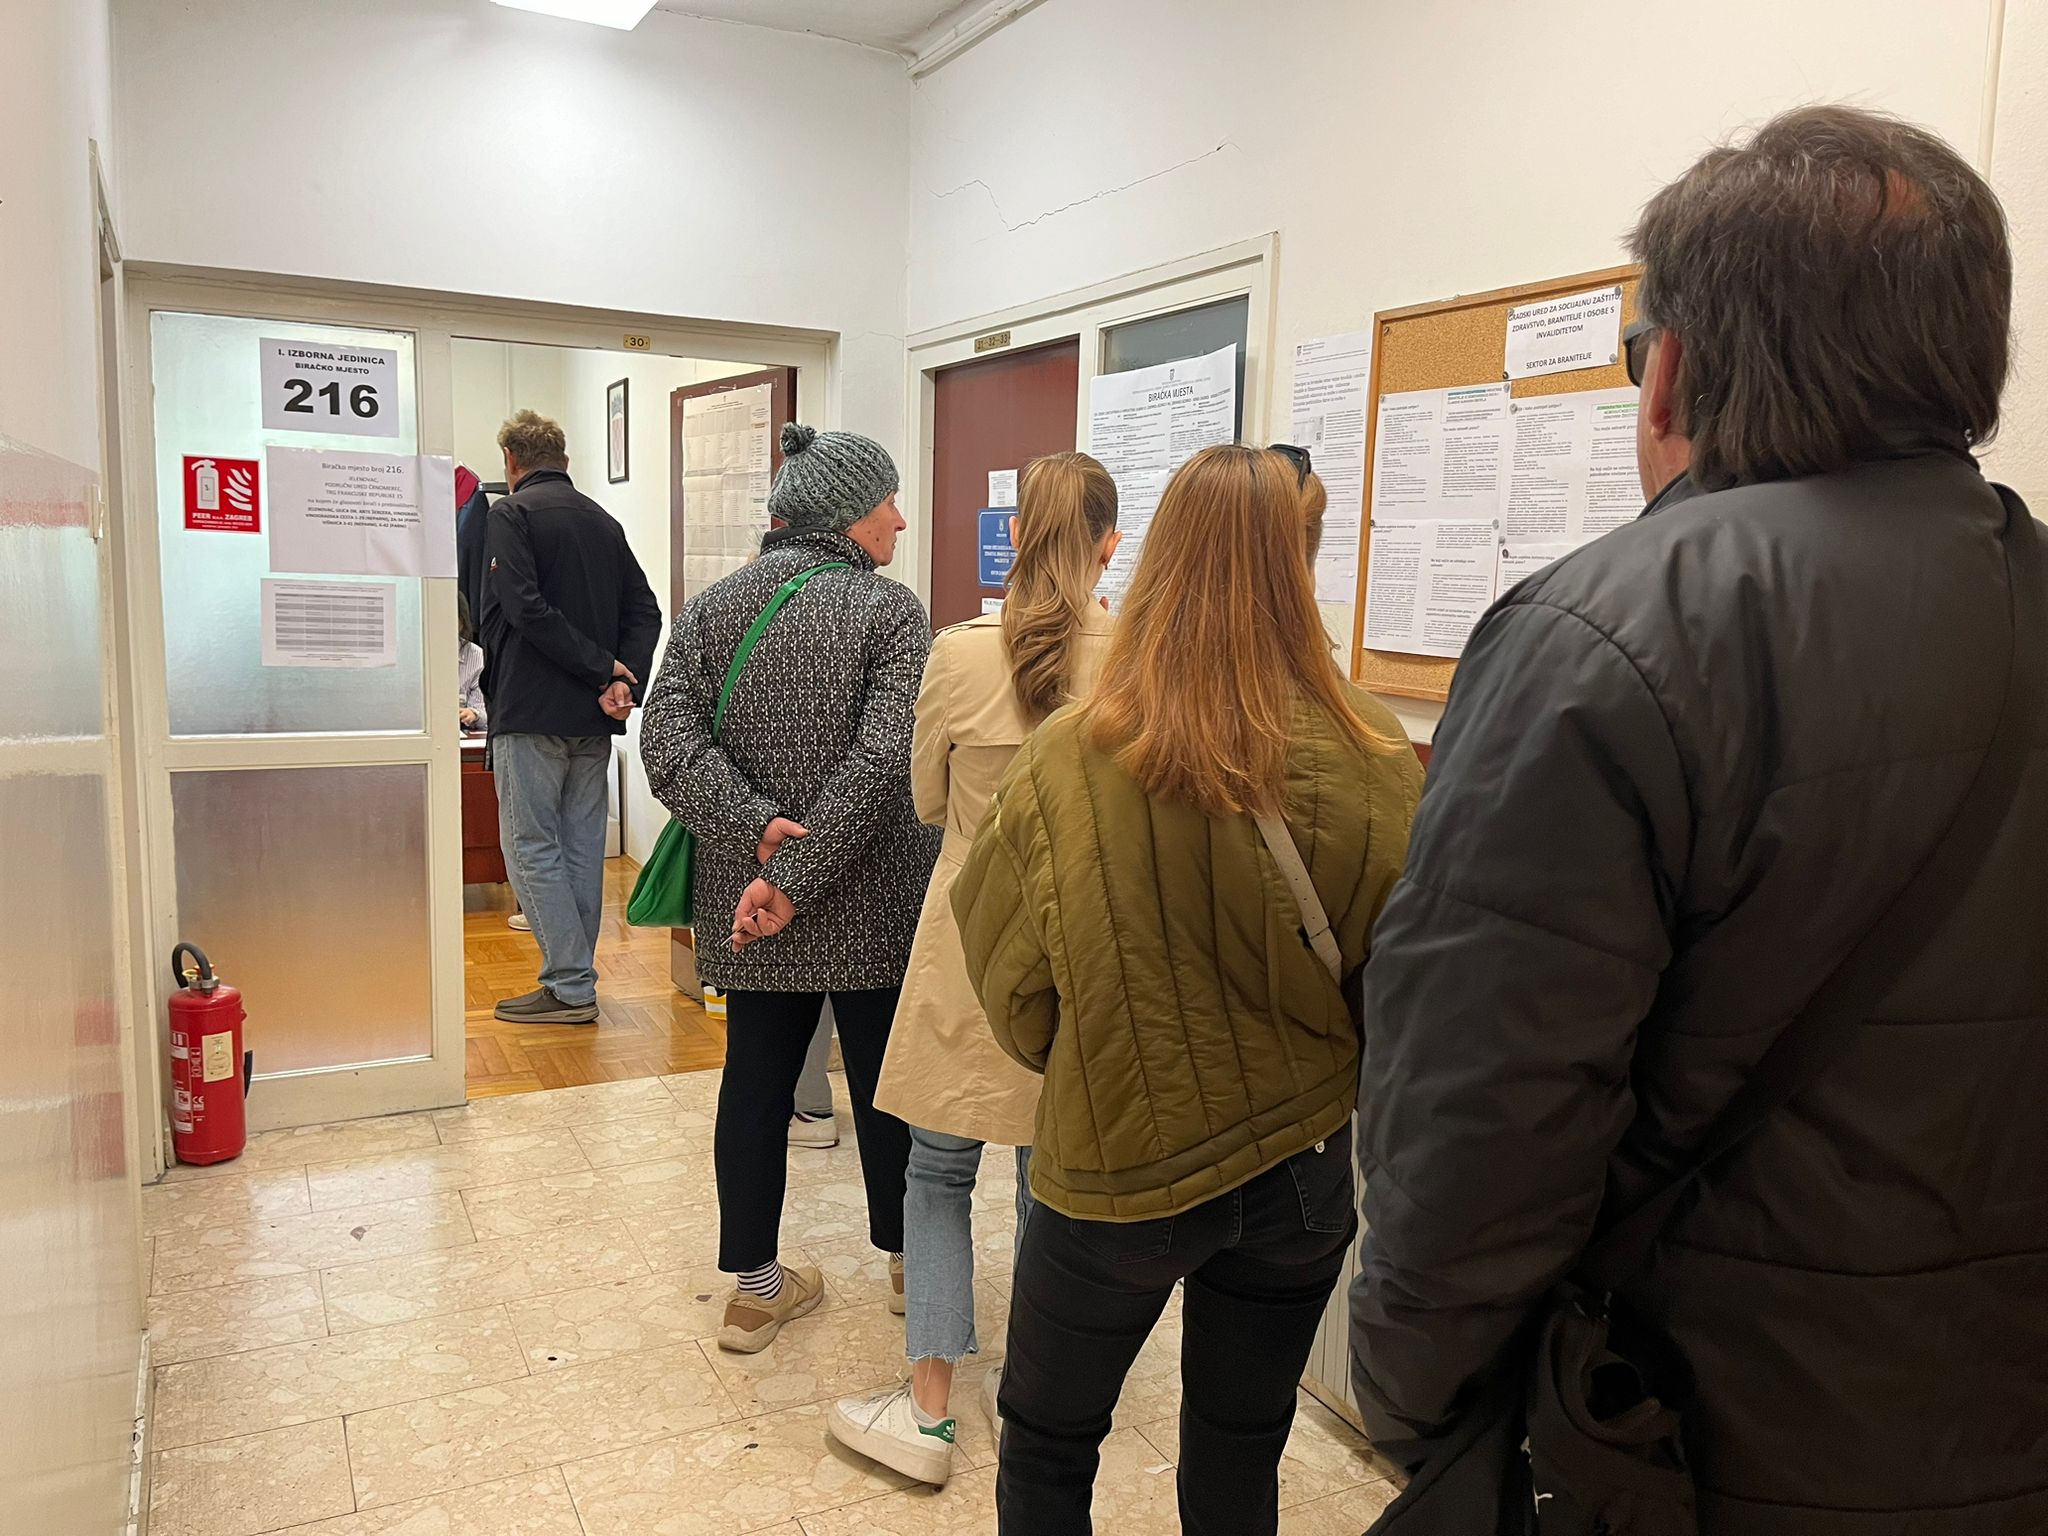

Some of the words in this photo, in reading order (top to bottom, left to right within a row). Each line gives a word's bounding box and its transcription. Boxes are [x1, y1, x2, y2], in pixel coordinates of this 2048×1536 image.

[1532, 308, 1548, 317] URED
[1558, 299, 1592, 312] SOCIJALNU
[1512, 320, 1546, 332] ZDRAVSTVO,
[1547, 311, 1582, 325] BRANITELJE
[1587, 307, 1609, 317] OSOBE
[1536, 324, 1583, 339] INVALIDITETOM
[630, 337, 644, 347] 30
[278, 348, 285, 356] I.
[288, 349, 334, 360] IZBORNA
[337, 354, 385, 365] JEDINICA
[1526, 359, 1548, 369] SEKTOR
[1548, 358, 1556, 366] ZA
[1557, 352, 1592, 363] BRANITELJE
[295, 362, 333, 372] BIRAČKO
[336, 366, 369, 375] MJESTO
[283, 378, 379, 418] 216
[1148, 389, 1171, 402] BIRAČKA
[1172, 386, 1194, 398] MJESTA
[386, 465, 404, 474] 216.
